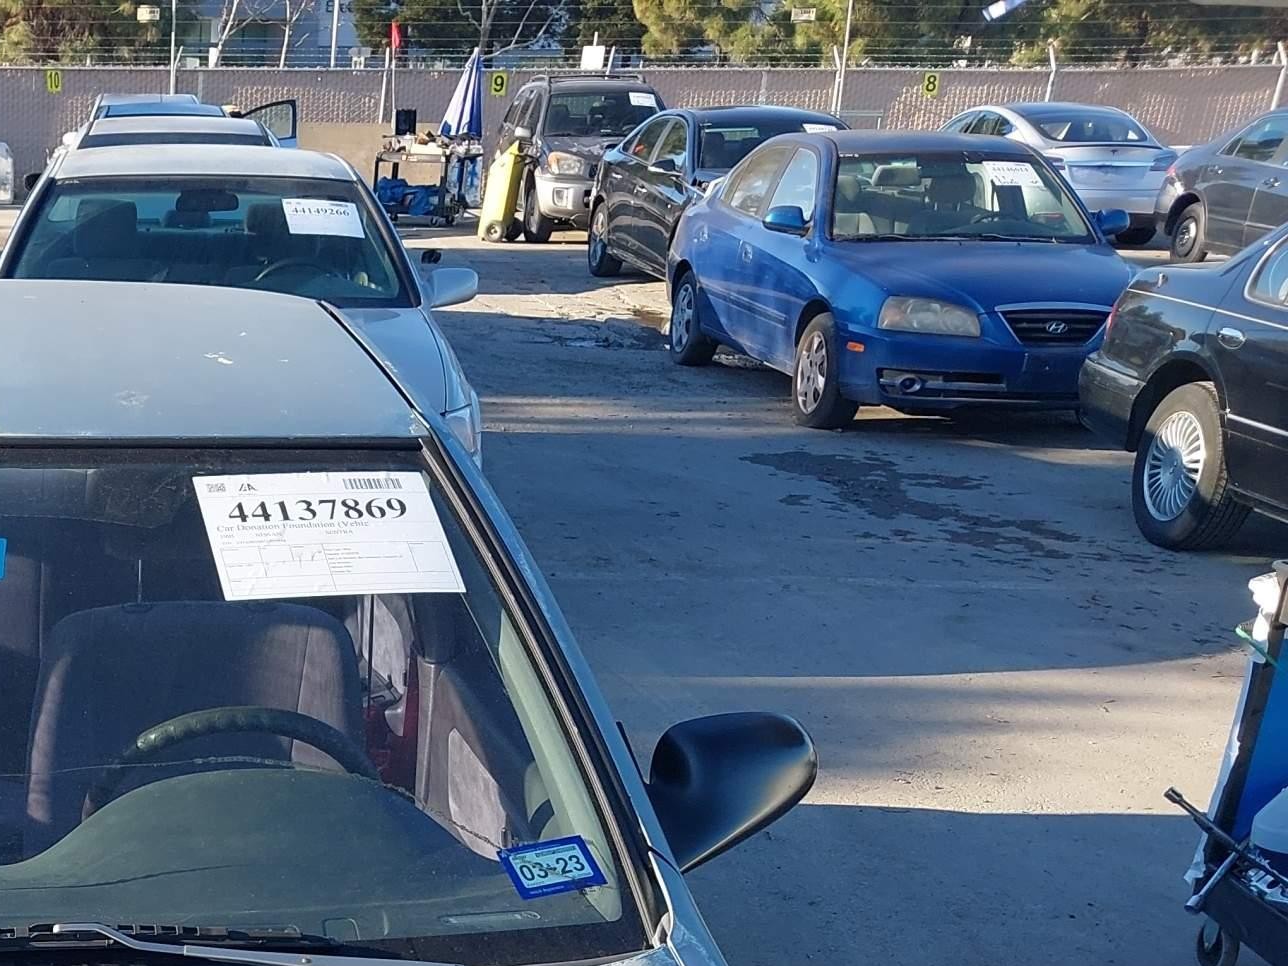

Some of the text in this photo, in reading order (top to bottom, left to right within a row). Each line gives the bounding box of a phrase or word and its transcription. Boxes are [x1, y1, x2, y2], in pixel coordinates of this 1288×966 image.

[48, 71, 59, 88] 10
[494, 75, 504, 92] 9
[926, 75, 936, 91] 8
[228, 498, 407, 522] 44137869
[237, 523, 280, 531] Donation
[283, 521, 335, 530] Foundation
